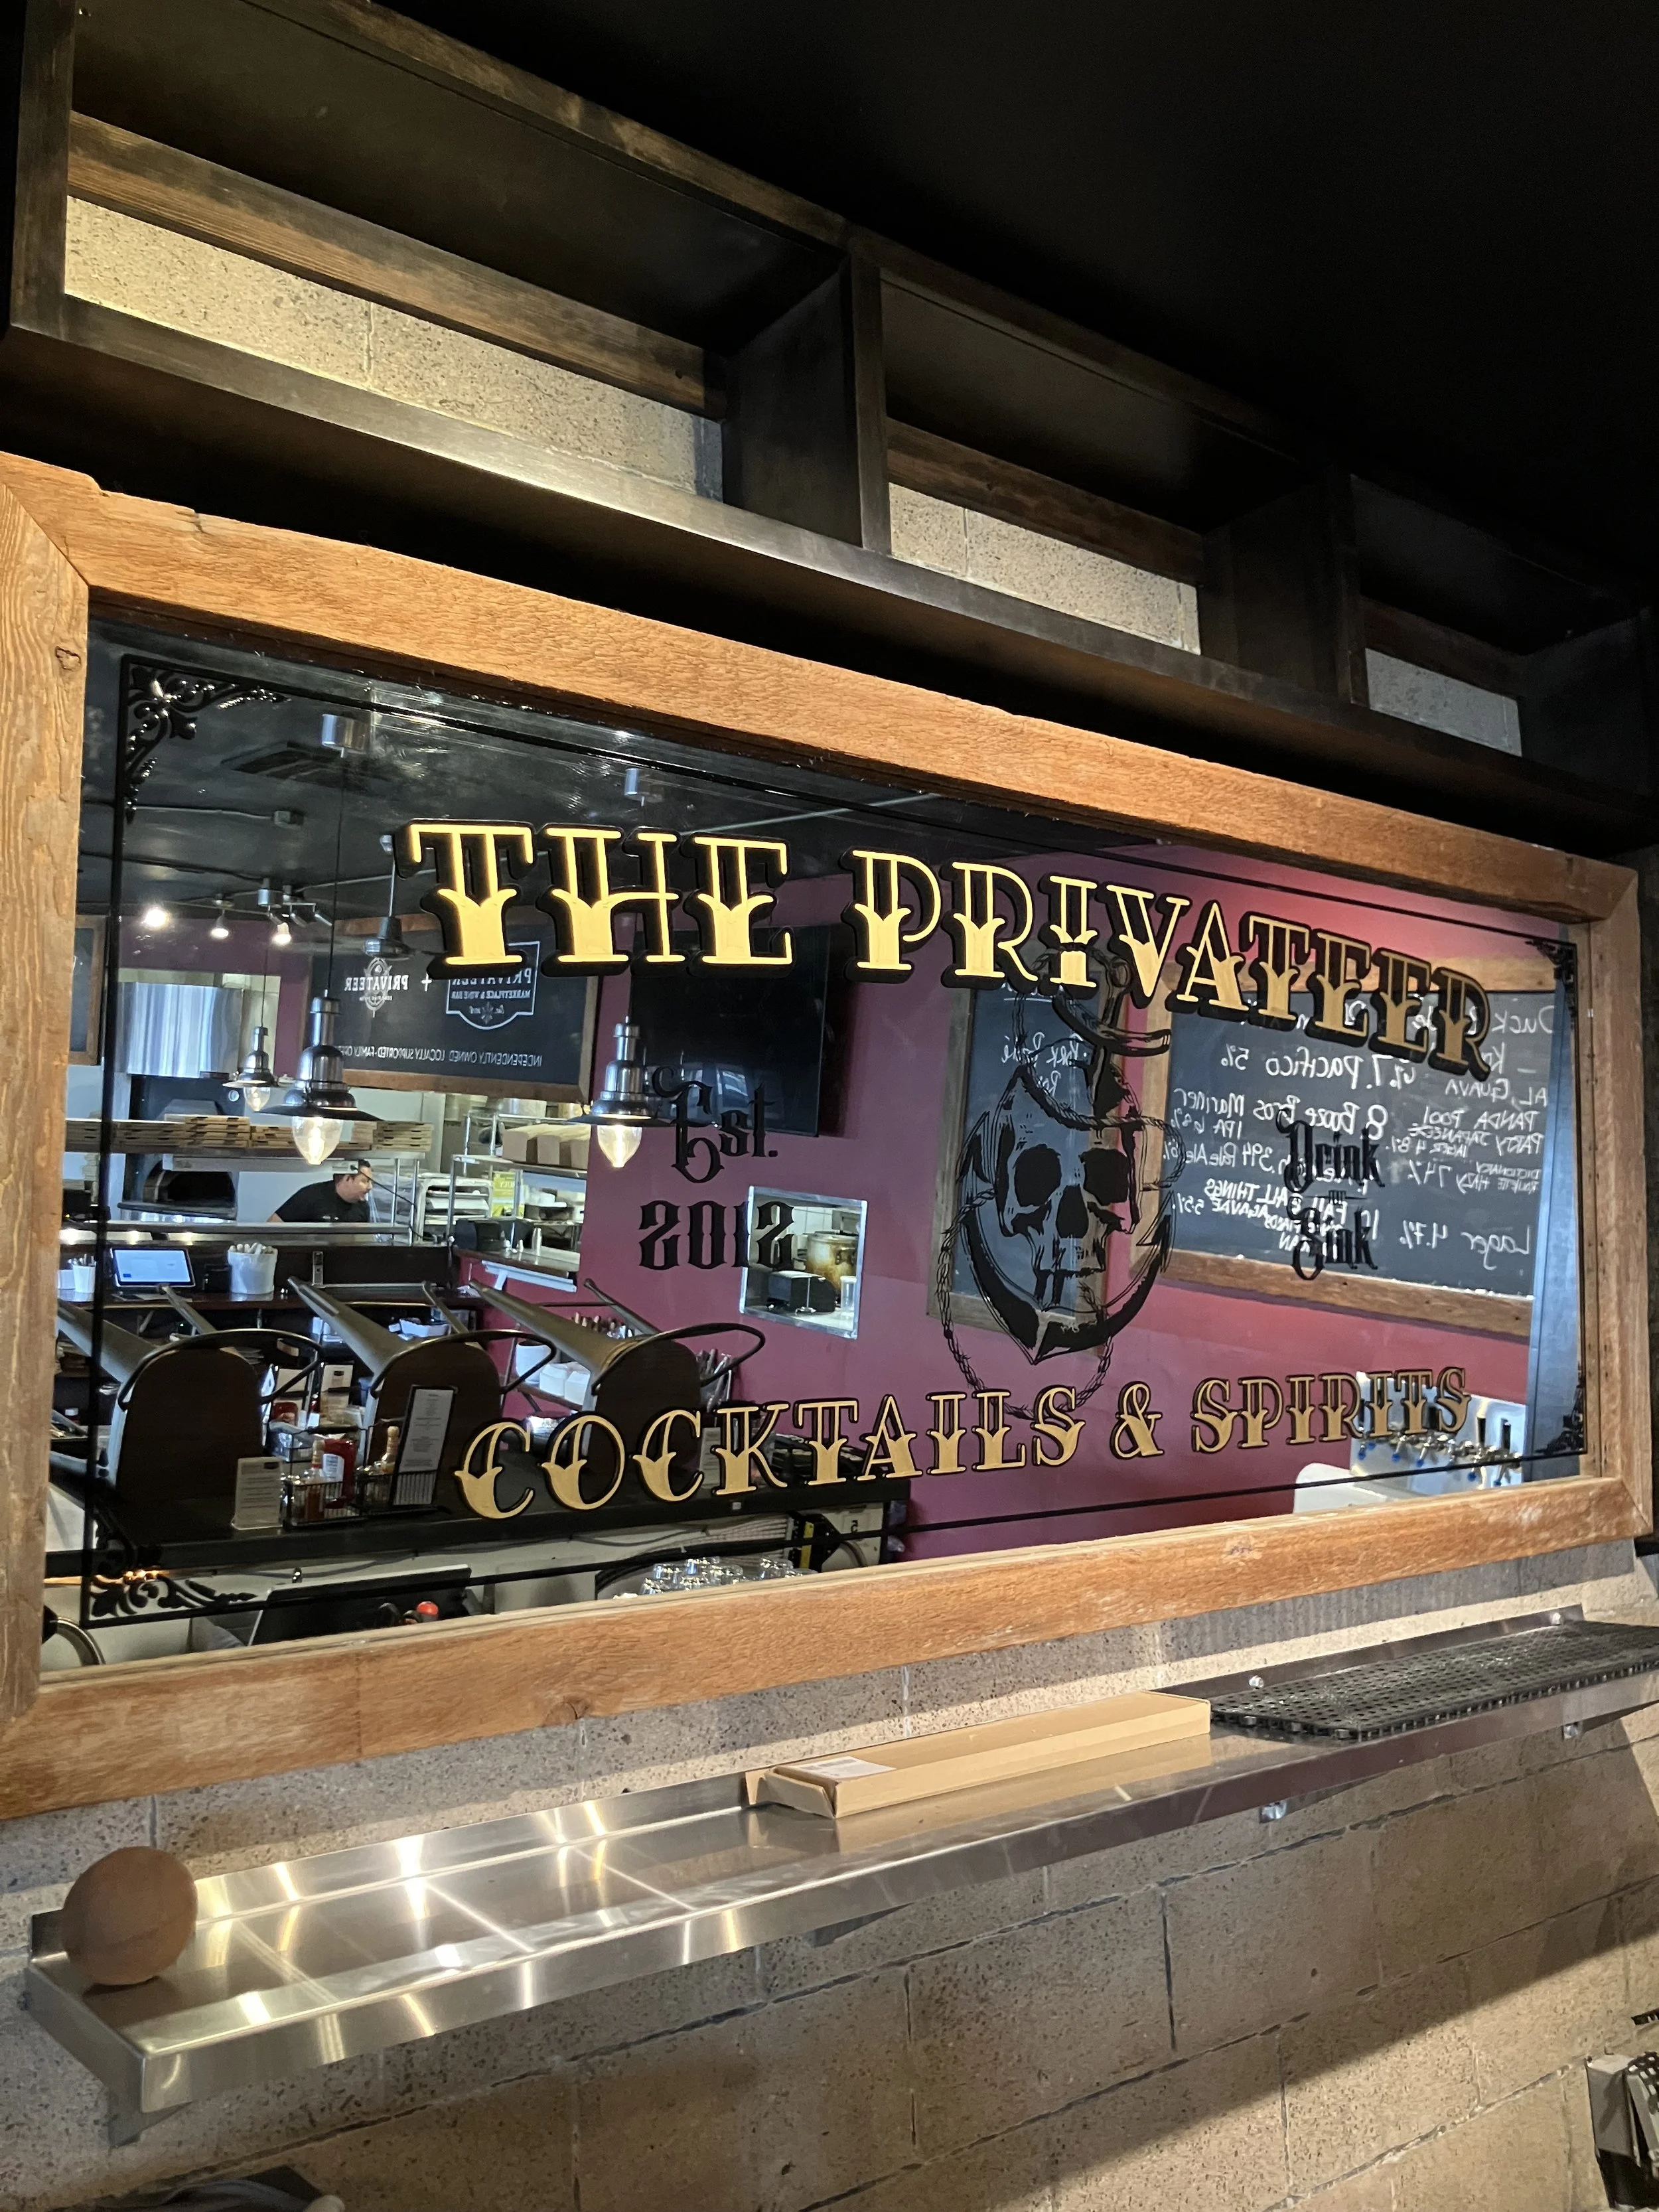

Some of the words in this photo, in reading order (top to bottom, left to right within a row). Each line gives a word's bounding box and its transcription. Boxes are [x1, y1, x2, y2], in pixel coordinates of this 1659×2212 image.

[397, 819, 794, 978] THE
[840, 847, 1492, 1080] PRIVATEER
[652, 1065, 778, 1183] Est.
[1275, 1109, 1386, 1193] Drink
[638, 1200, 794, 1270] 2012
[1287, 1201, 1378, 1280] Sink
[455, 1386, 1086, 1520] COCKTAILS
[1112, 1380, 1164, 1459] &
[1190, 1366, 1472, 1454] SPIRITS
